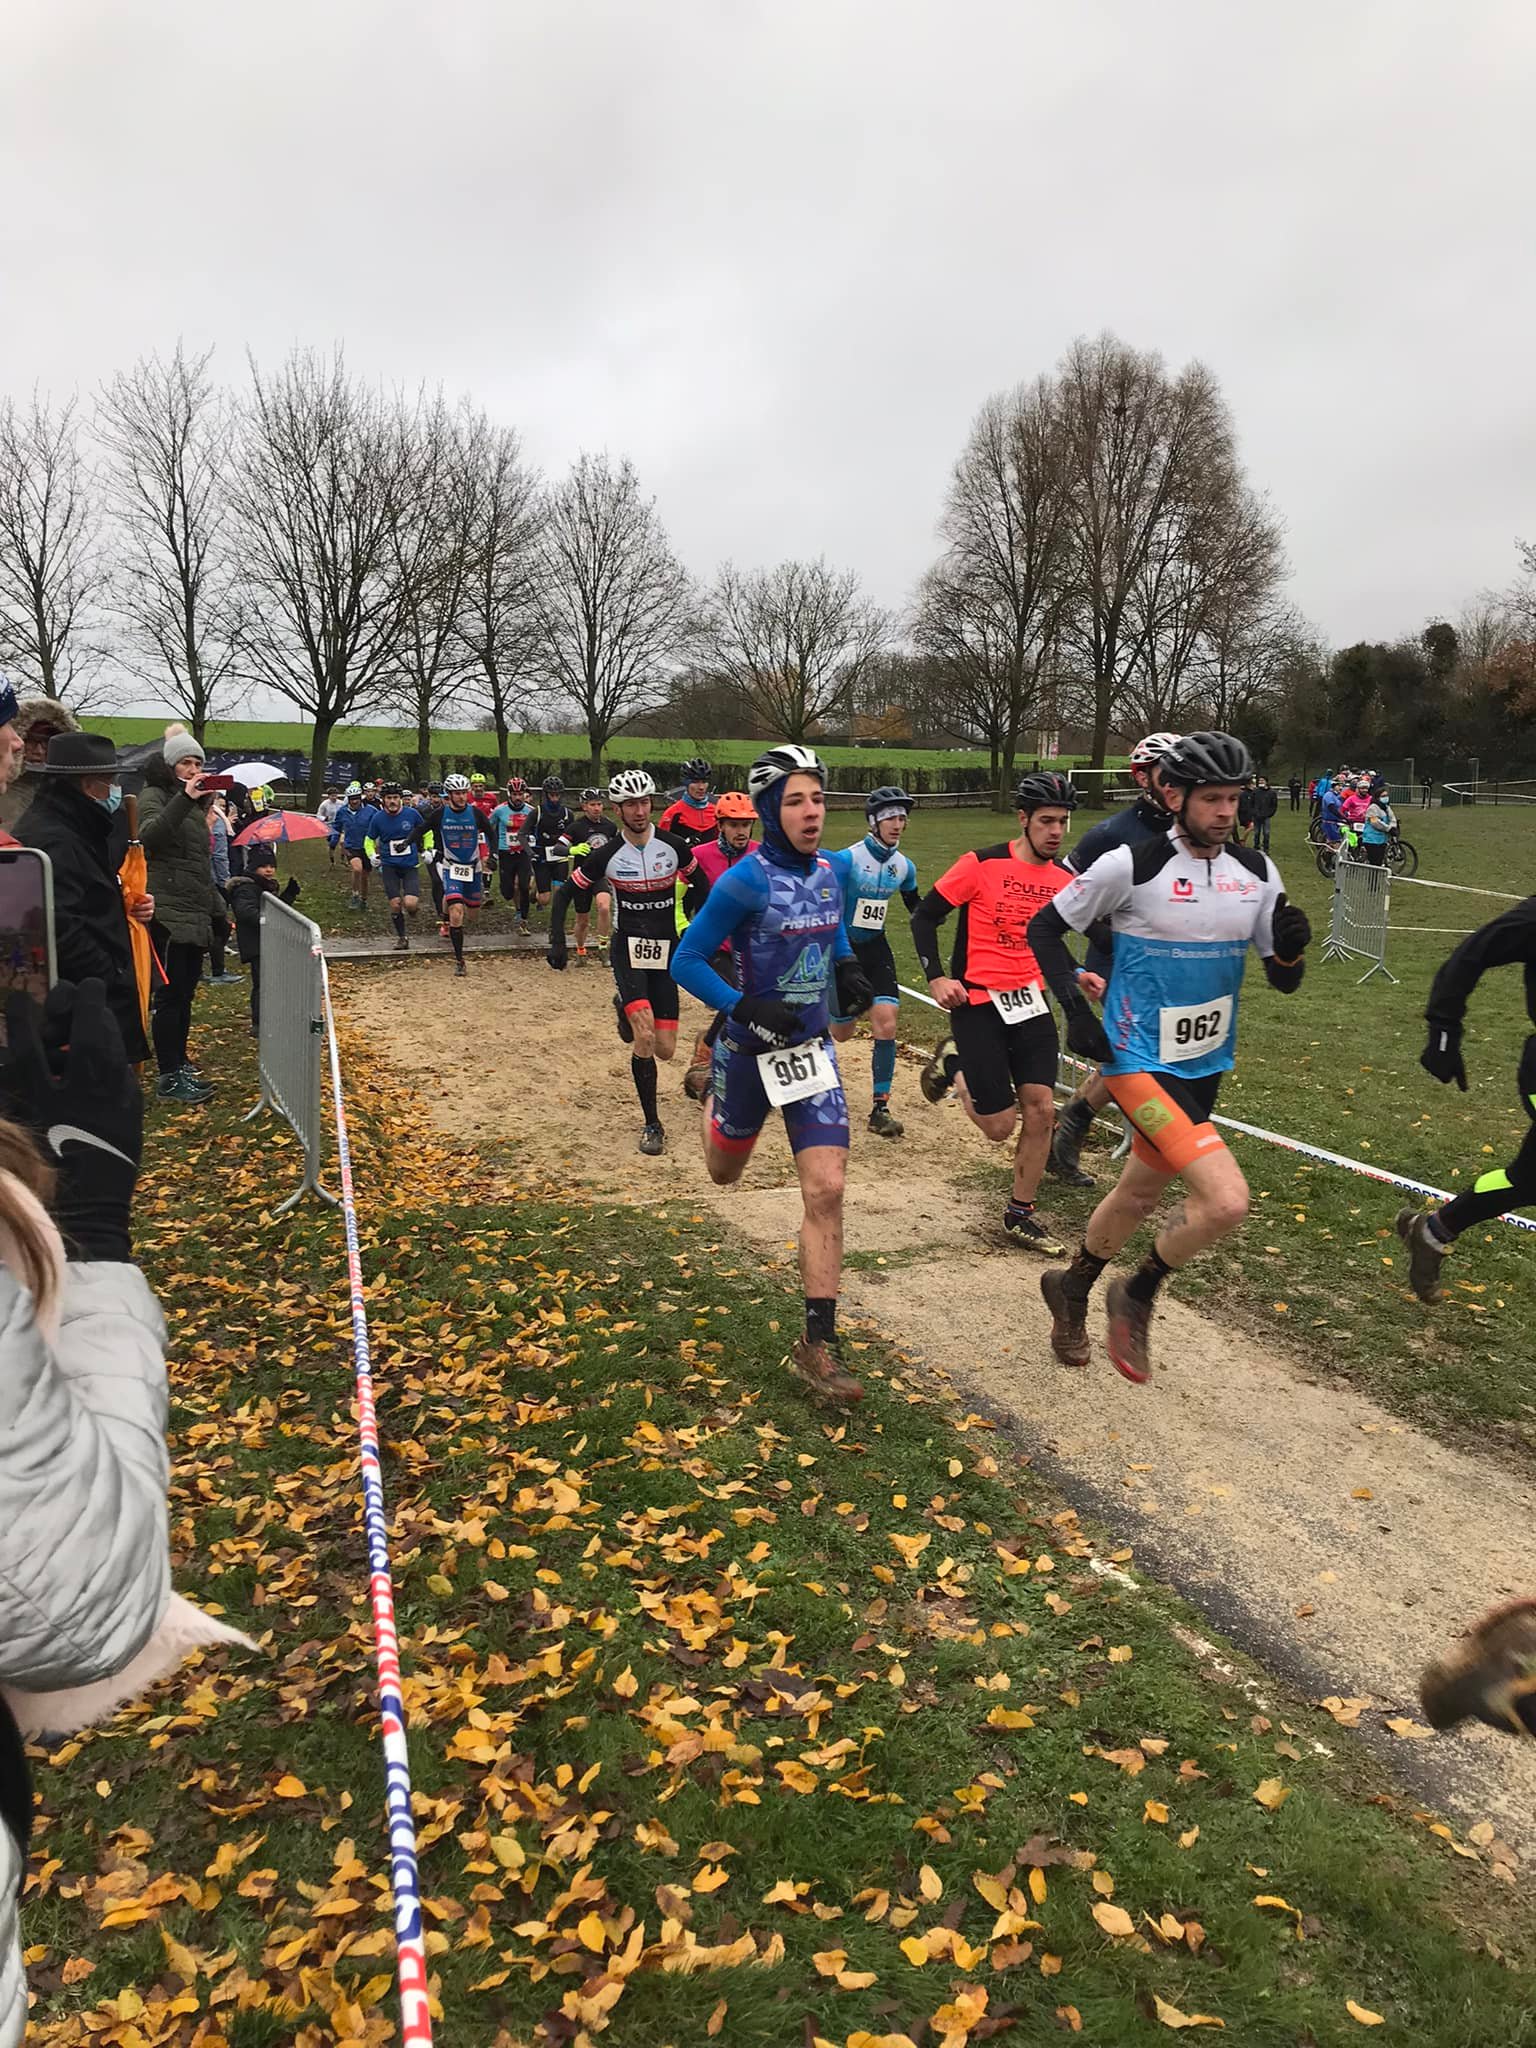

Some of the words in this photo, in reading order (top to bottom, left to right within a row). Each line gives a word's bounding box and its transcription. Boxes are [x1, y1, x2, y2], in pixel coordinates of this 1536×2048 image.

[454, 866, 470, 877] 926
[621, 897, 674, 911] ROTOR
[862, 905, 885, 921] 949
[634, 943, 662, 960] 958
[1000, 986, 1033, 1012] 946
[1175, 1010, 1221, 1044] 962
[774, 1052, 818, 1087] 967
